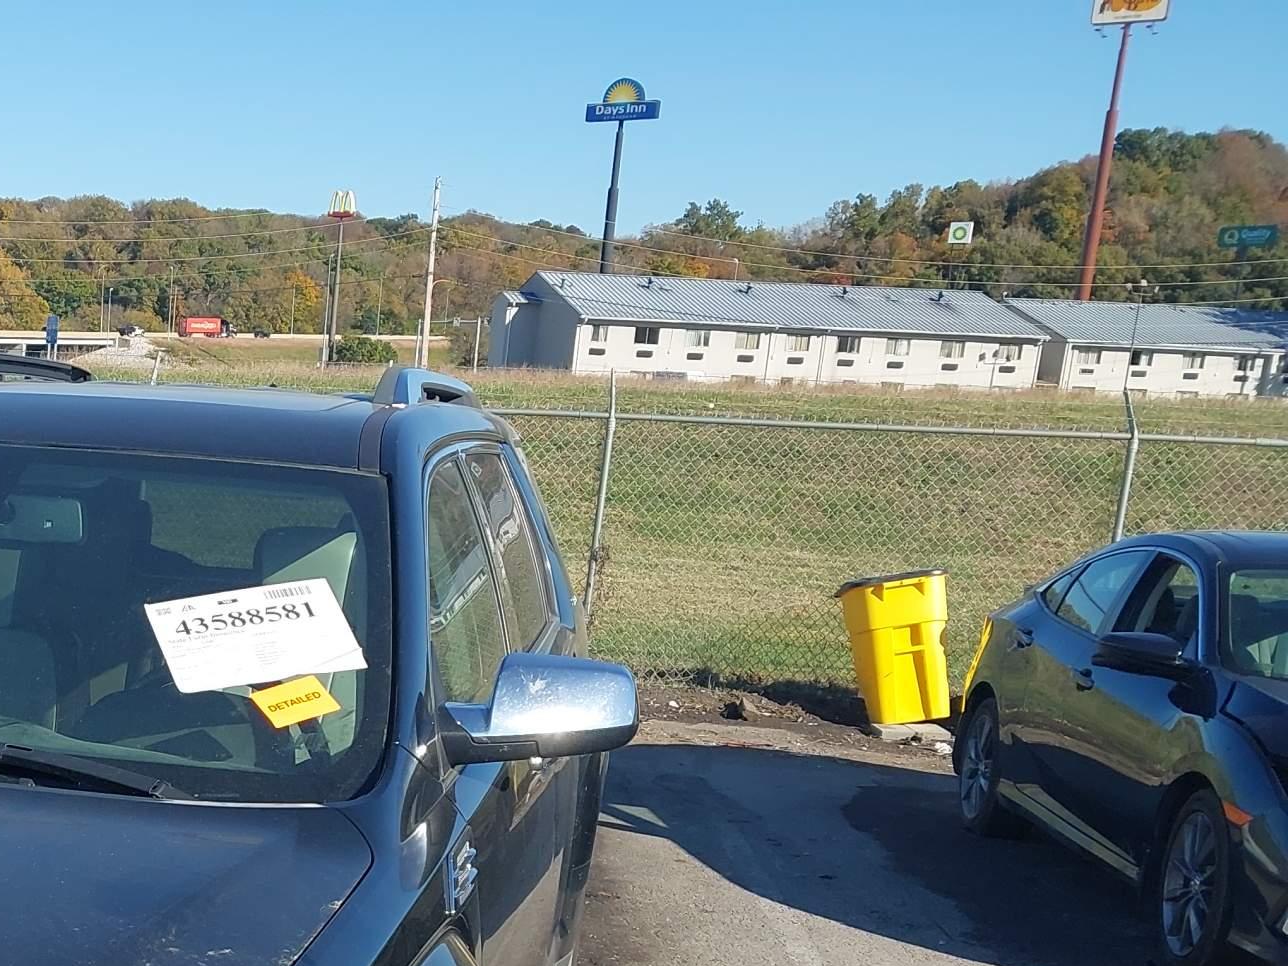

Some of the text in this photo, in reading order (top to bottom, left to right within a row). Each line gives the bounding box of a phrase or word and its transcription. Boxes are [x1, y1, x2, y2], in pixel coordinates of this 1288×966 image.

[595, 103, 647, 116] Days Inn
[175, 601, 316, 636] 43588581
[267, 691, 321, 713] DETAILED
